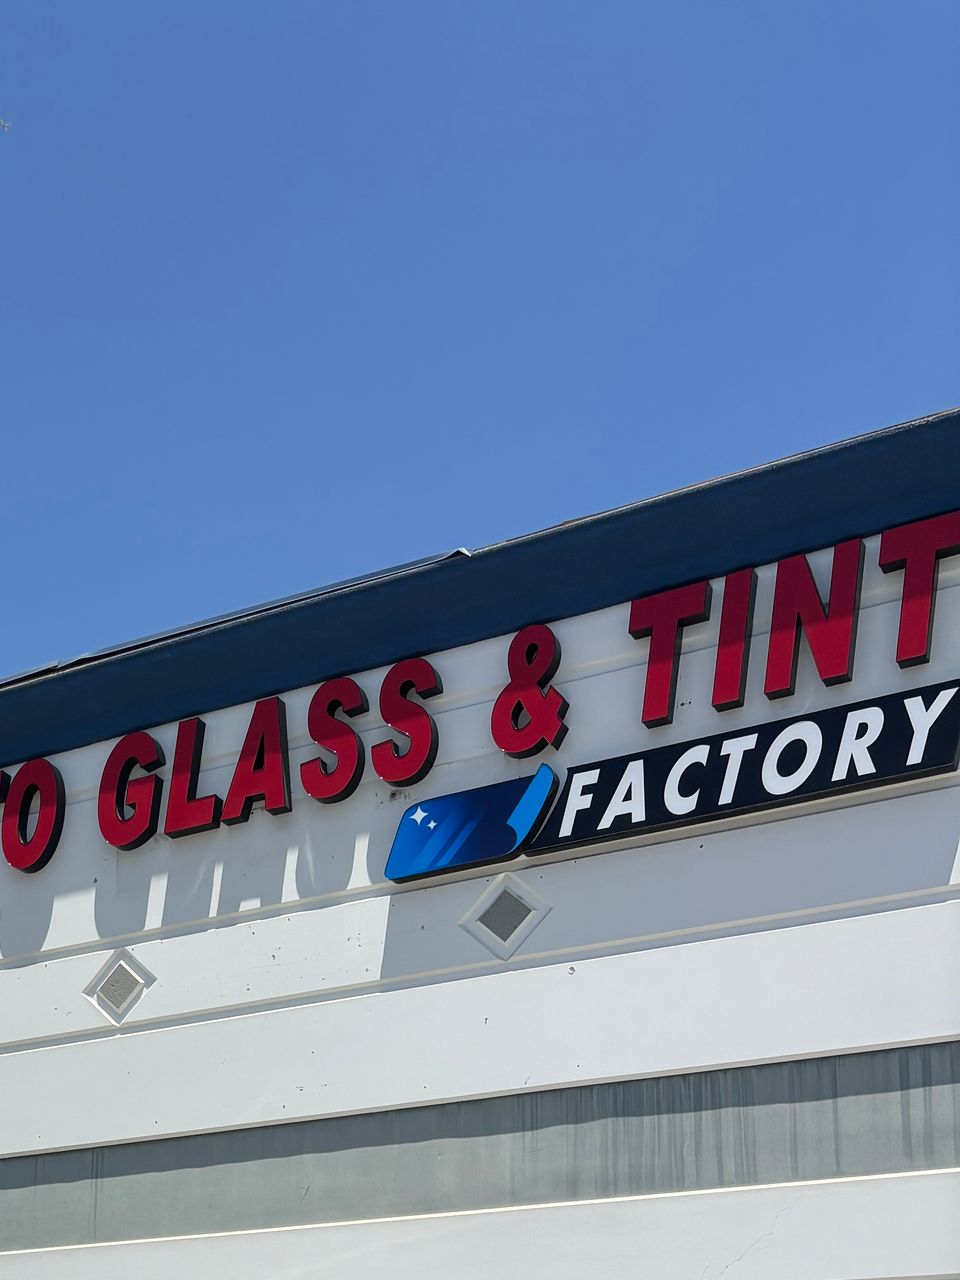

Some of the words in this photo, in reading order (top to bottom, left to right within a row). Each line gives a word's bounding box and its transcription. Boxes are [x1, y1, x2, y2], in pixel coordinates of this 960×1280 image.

[97, 656, 444, 852] GLASS
[491, 623, 570, 759] &
[628, 510, 960, 729] TINT
[558, 687, 960, 838] FACTORY
